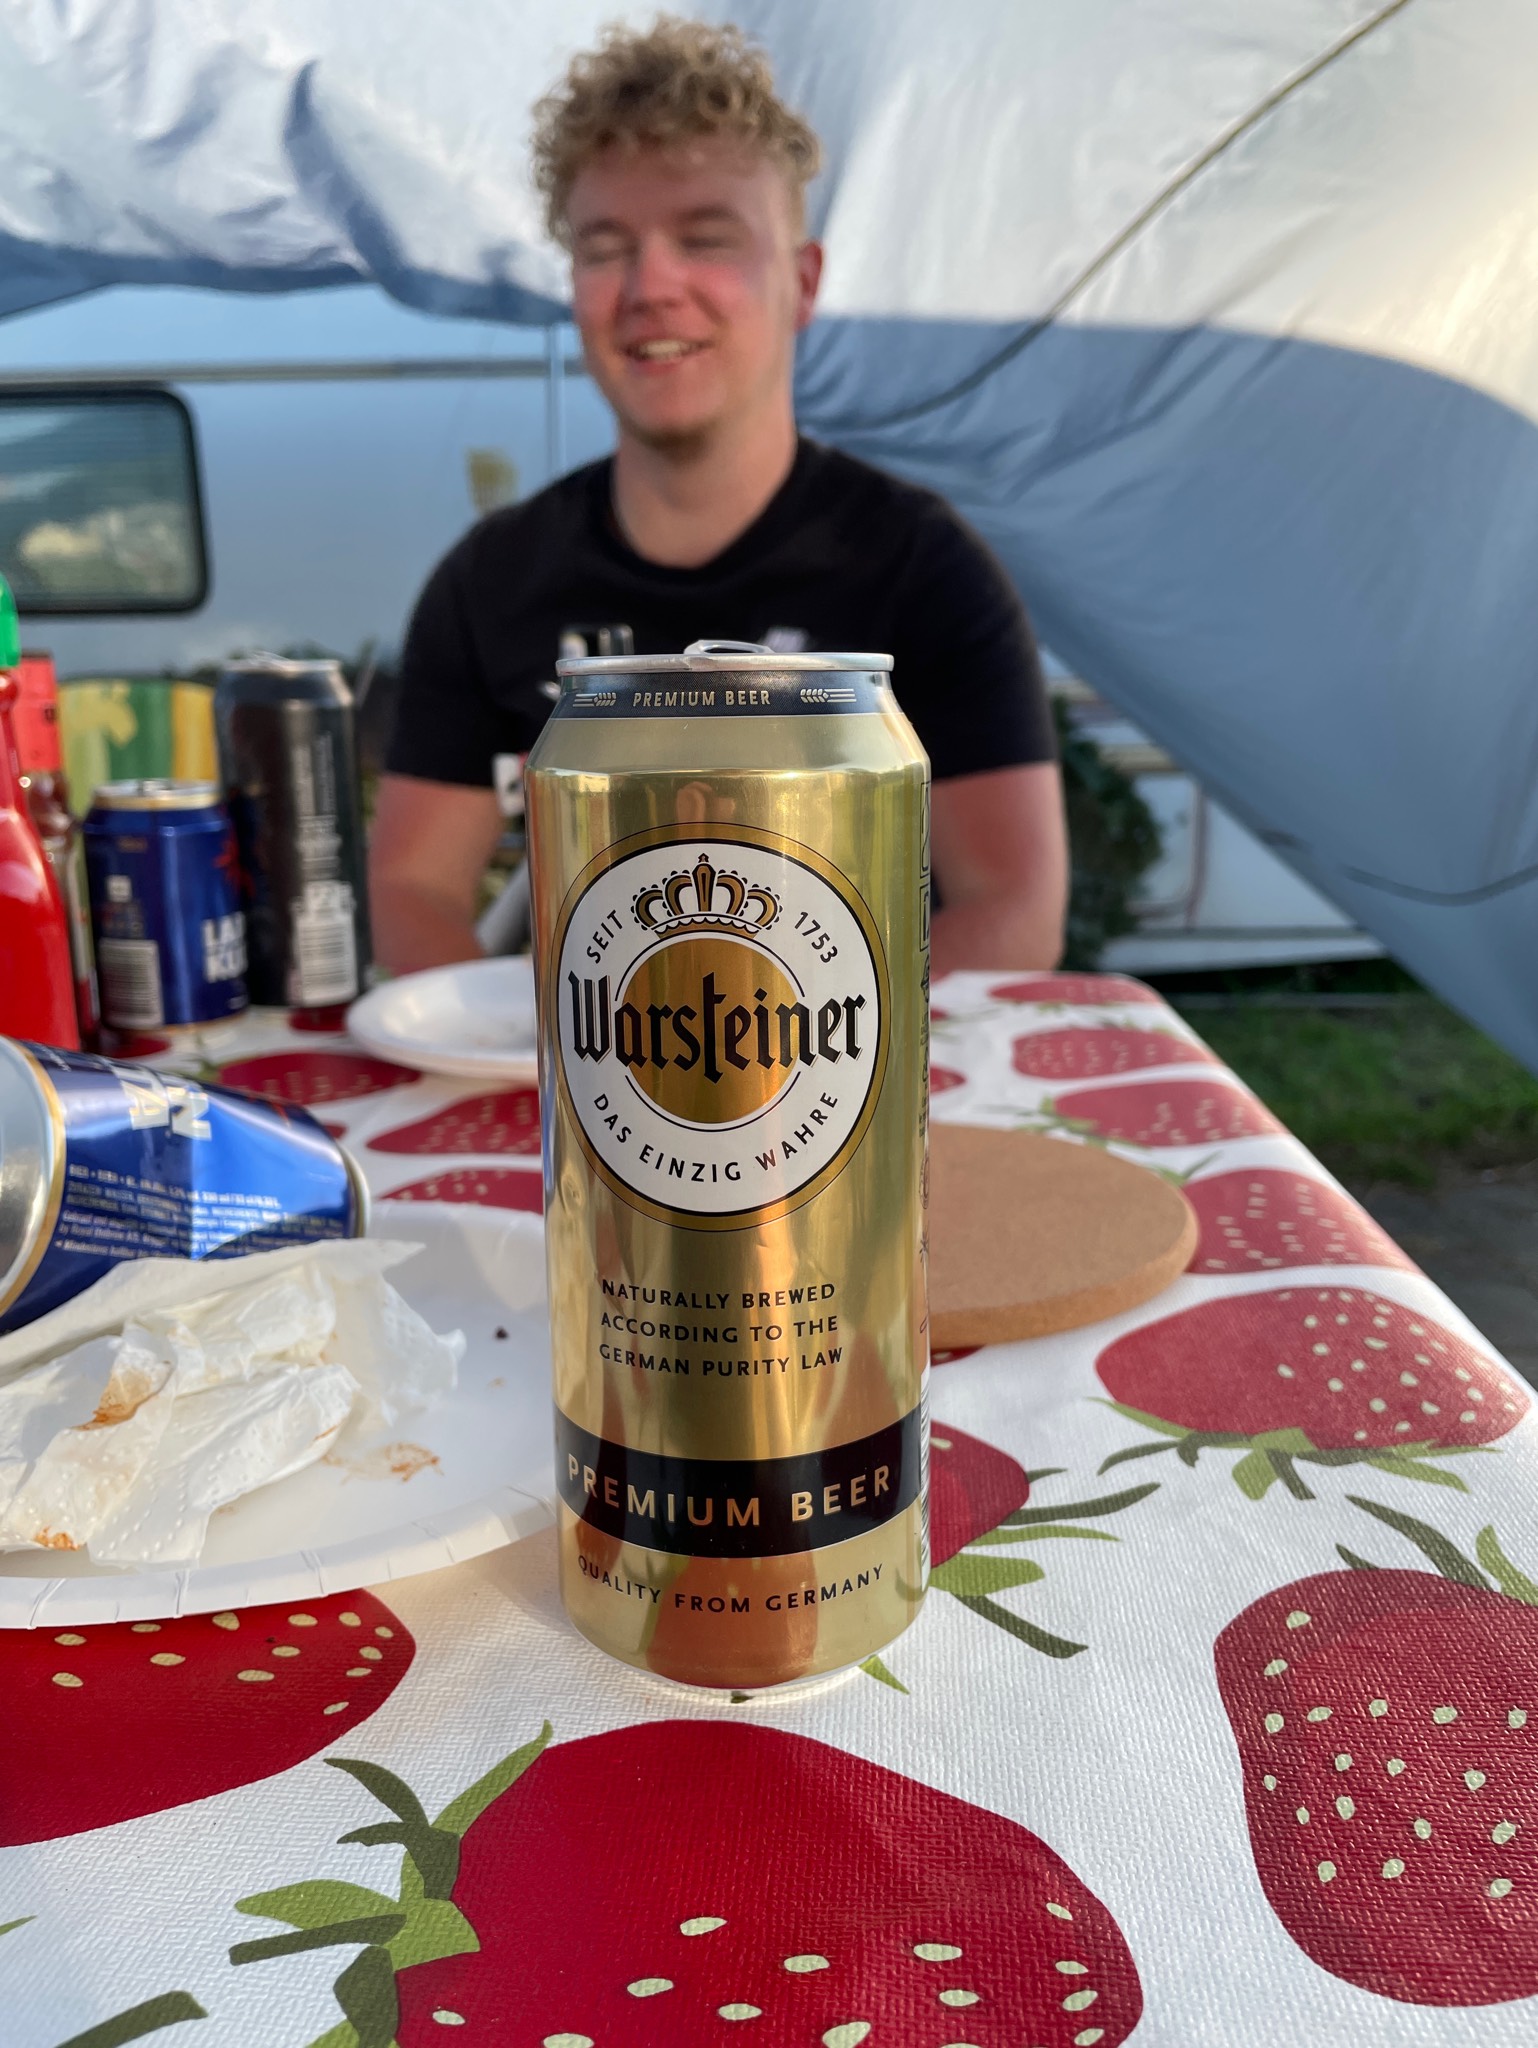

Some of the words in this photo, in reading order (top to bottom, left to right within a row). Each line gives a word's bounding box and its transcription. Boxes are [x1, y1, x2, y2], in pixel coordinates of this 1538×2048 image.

[633, 691, 715, 707] PREMIUM
[725, 690, 771, 706] BEER
[586, 909, 623, 964] SEIT
[794, 911, 838, 964] 1753
[568, 970, 866, 1084] Warsteiner
[594, 1093, 632, 1143] DAS
[639, 1144, 741, 1183] EINZIG
[755, 1092, 838, 1171] WAHRE
[602, 1279, 730, 1310] NATURALLY
[742, 1283, 836, 1309] BREWED
[601, 1312, 738, 1343] ACCORDING
[749, 1325, 782, 1342] TO
[793, 1315, 838, 1338] THE
[599, 1343, 690, 1375] GERMAN
[702, 1357, 790, 1377] PURITY
[802, 1347, 843, 1370] LAW
[567, 1453, 760, 1527] PREMIUM
[791, 1465, 890, 1523] BEER
[578, 1555, 661, 1604] QUALITY
[674, 1593, 751, 1613] FROM
[766, 1563, 884, 1612] GERMANY
